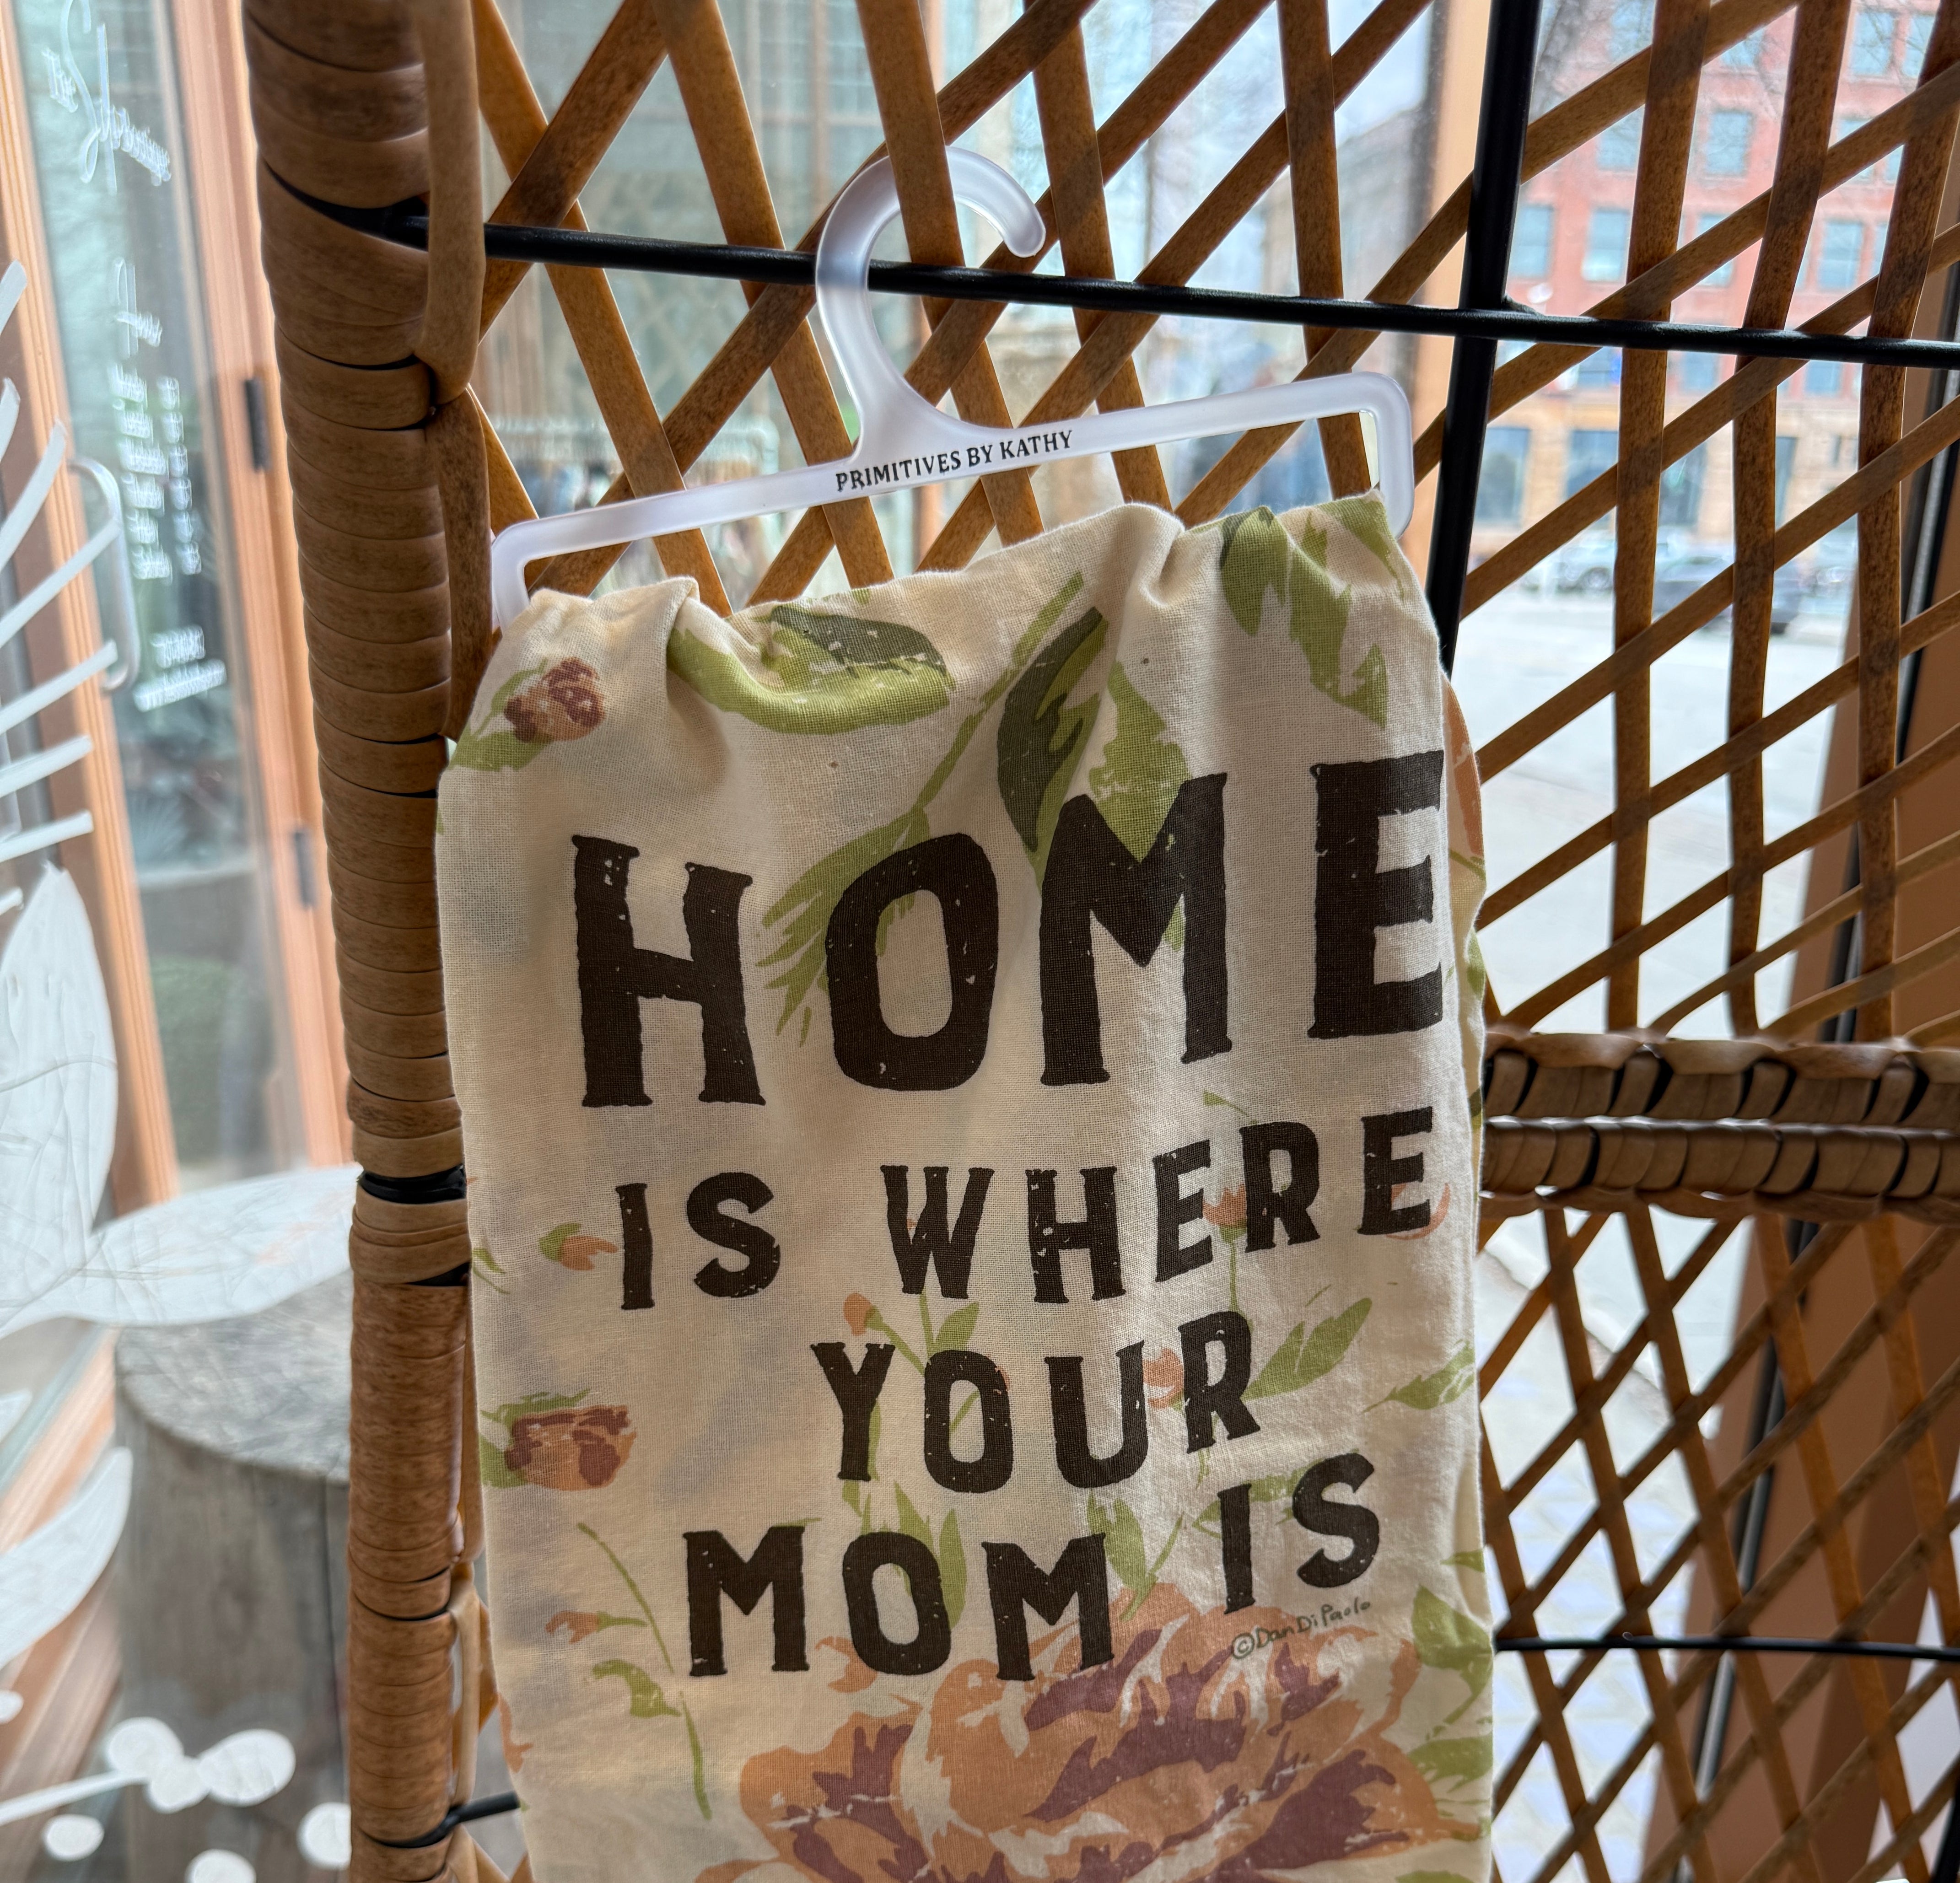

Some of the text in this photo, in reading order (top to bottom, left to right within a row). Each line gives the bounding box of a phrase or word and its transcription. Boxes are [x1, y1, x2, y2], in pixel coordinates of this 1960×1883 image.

[835, 430, 1072, 492] PRIMITIVES BY KATHY
[571, 749, 1445, 1108] HOME
[614, 1106, 1433, 1311] IS WHERE
[810, 1310, 1261, 1494] YOUR
[682, 1452, 1380, 1682] MOM IS
